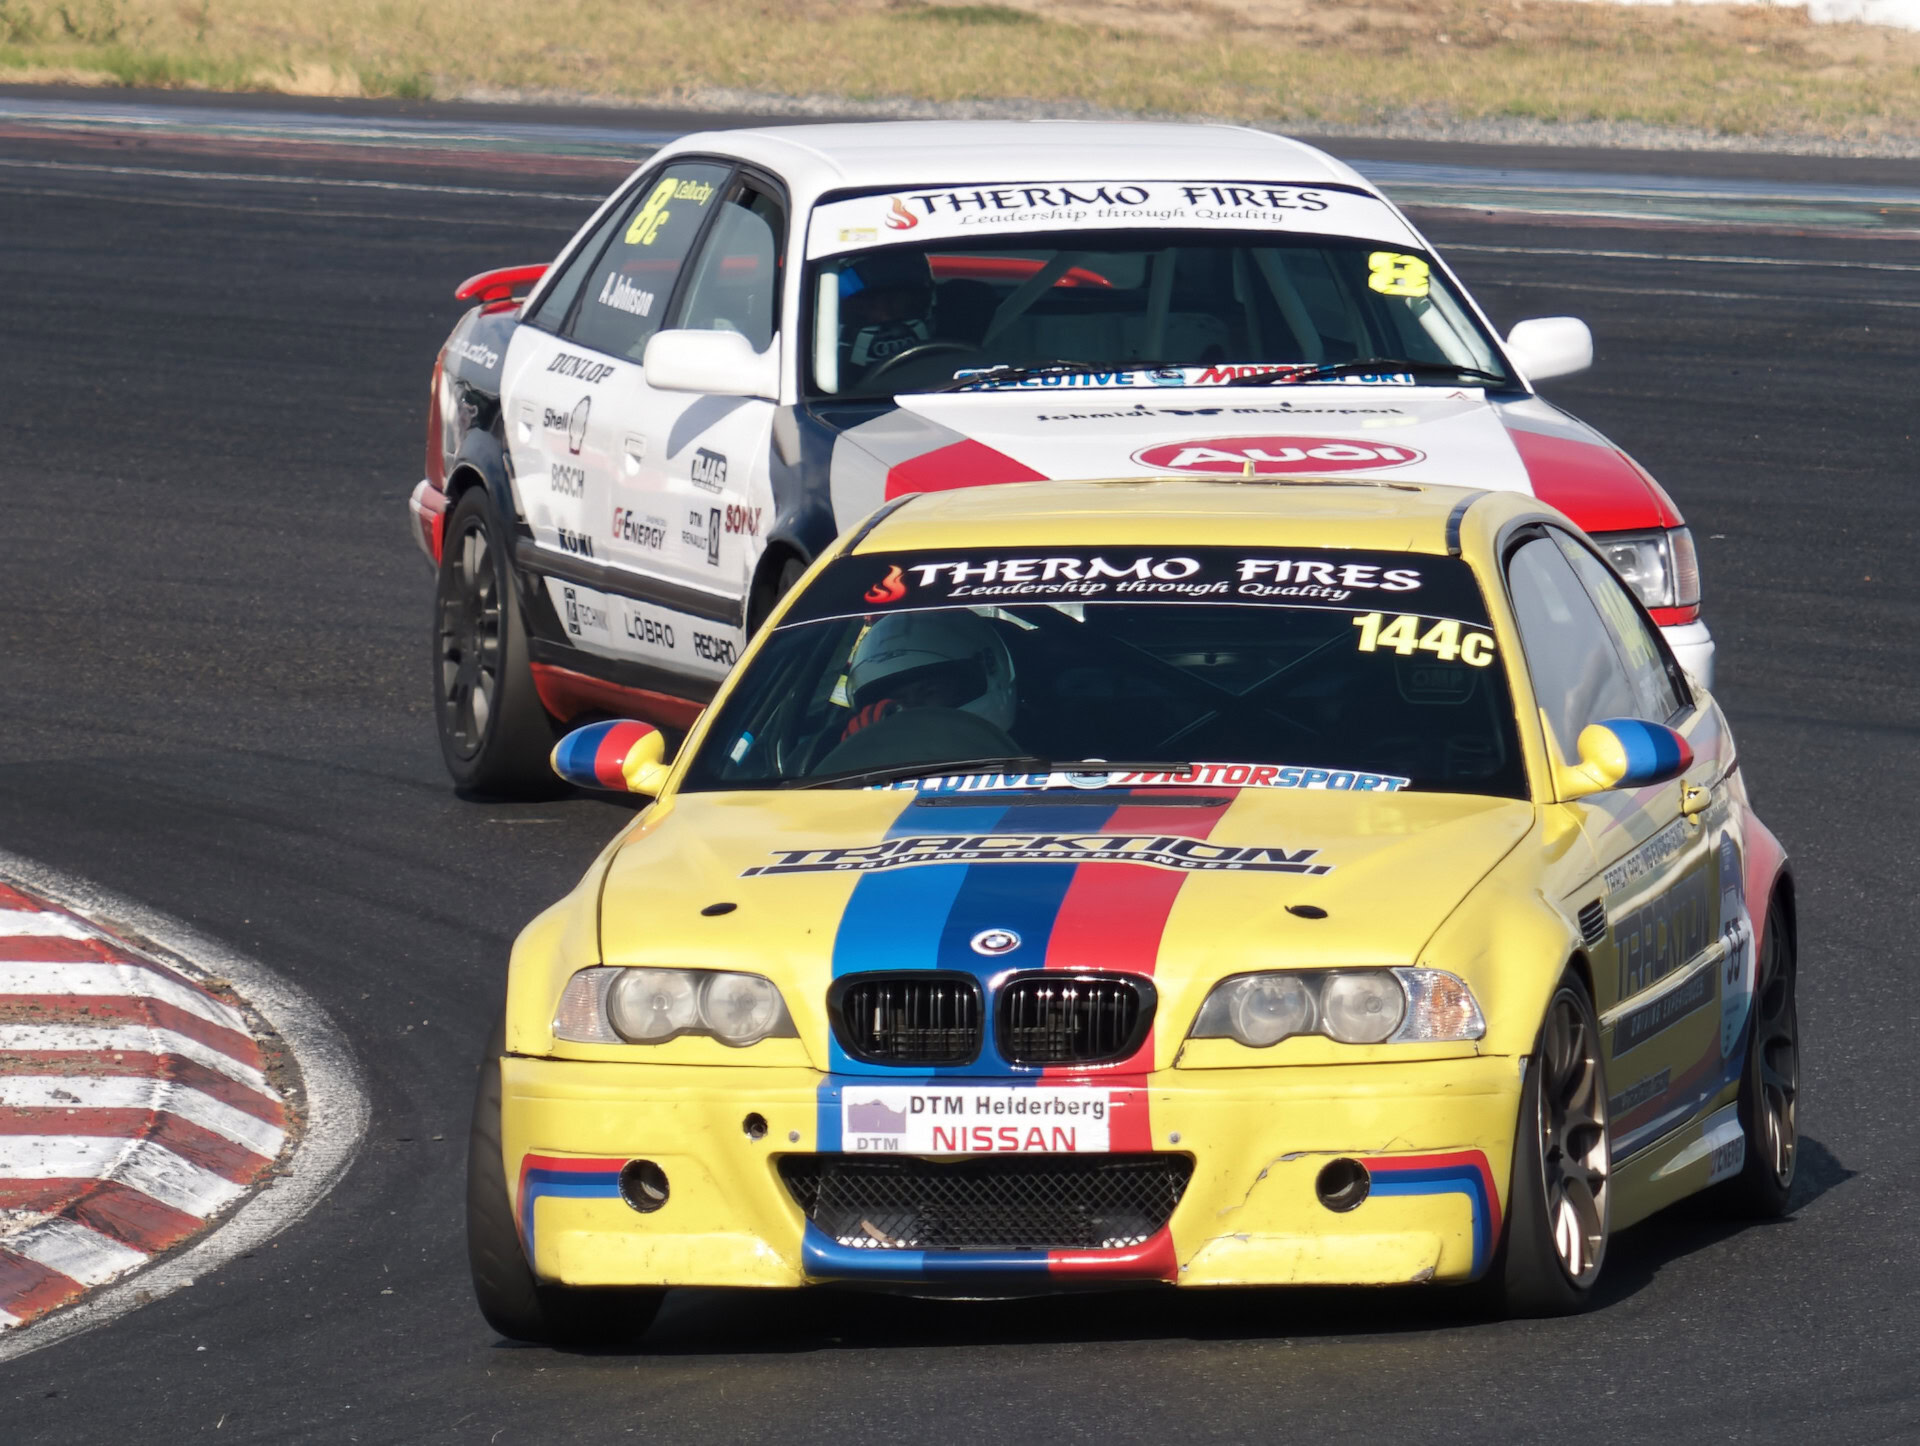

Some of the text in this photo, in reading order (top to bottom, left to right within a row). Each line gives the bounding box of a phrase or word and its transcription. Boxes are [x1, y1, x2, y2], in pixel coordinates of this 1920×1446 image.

[908, 185, 1329, 215] THERMO FIRES
[959, 207, 1284, 225] Leadership through Quality
[1367, 250, 1430, 297] 8
[599, 271, 655, 318] A Johnson
[546, 352, 616, 385] DUNLOP
[543, 408, 569, 431] Shell
[551, 463, 585, 499] BOSCH
[558, 527, 595, 558] KONI
[907, 556, 1422, 591] THERMO FIRES
[946, 578, 1352, 601] Leadership through Quality
[624, 610, 675, 649] LÖBRO
[693, 631, 737, 667] RECARO
[771, 835, 1321, 865] TRACKTION
[833, 850, 1244, 871] DRIVING EXPERIENCES
[909, 1095, 1105, 1120] DTM Helderberg
[856, 1137, 900, 1151] DTM
[932, 1126, 1077, 1151] NISSAN
